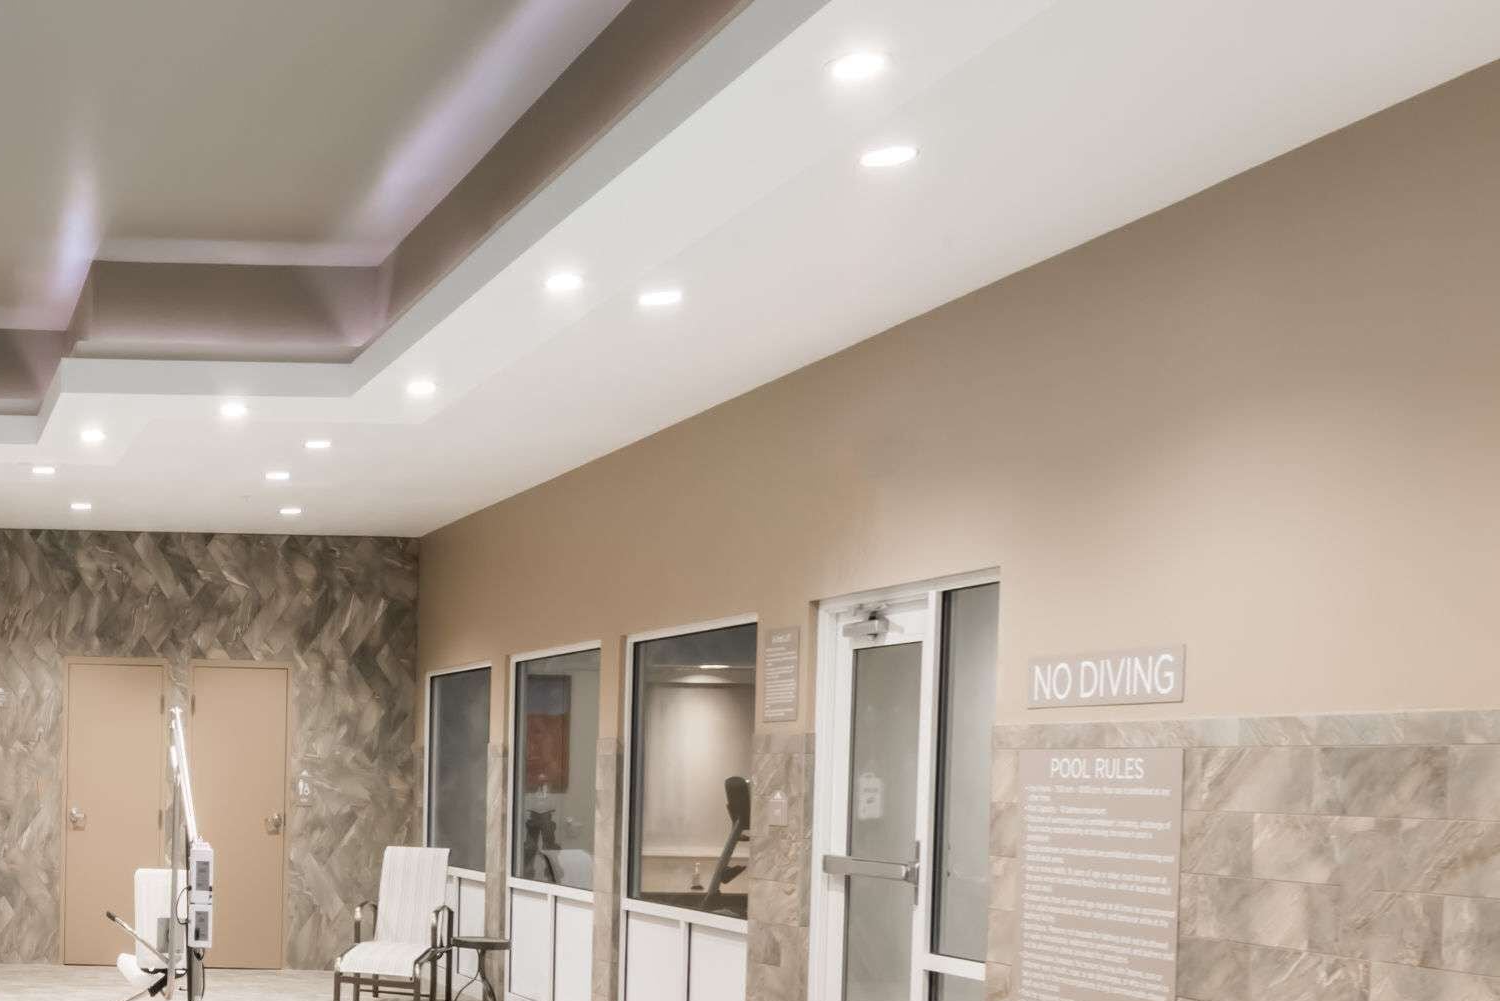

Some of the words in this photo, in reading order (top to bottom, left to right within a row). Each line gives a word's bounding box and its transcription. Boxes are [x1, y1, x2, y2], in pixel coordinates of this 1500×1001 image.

[1033, 661, 1072, 700] NO
[1079, 654, 1175, 698] DIVING
[1050, 757, 1090, 779] POOL
[1094, 757, 1145, 780] RULES
